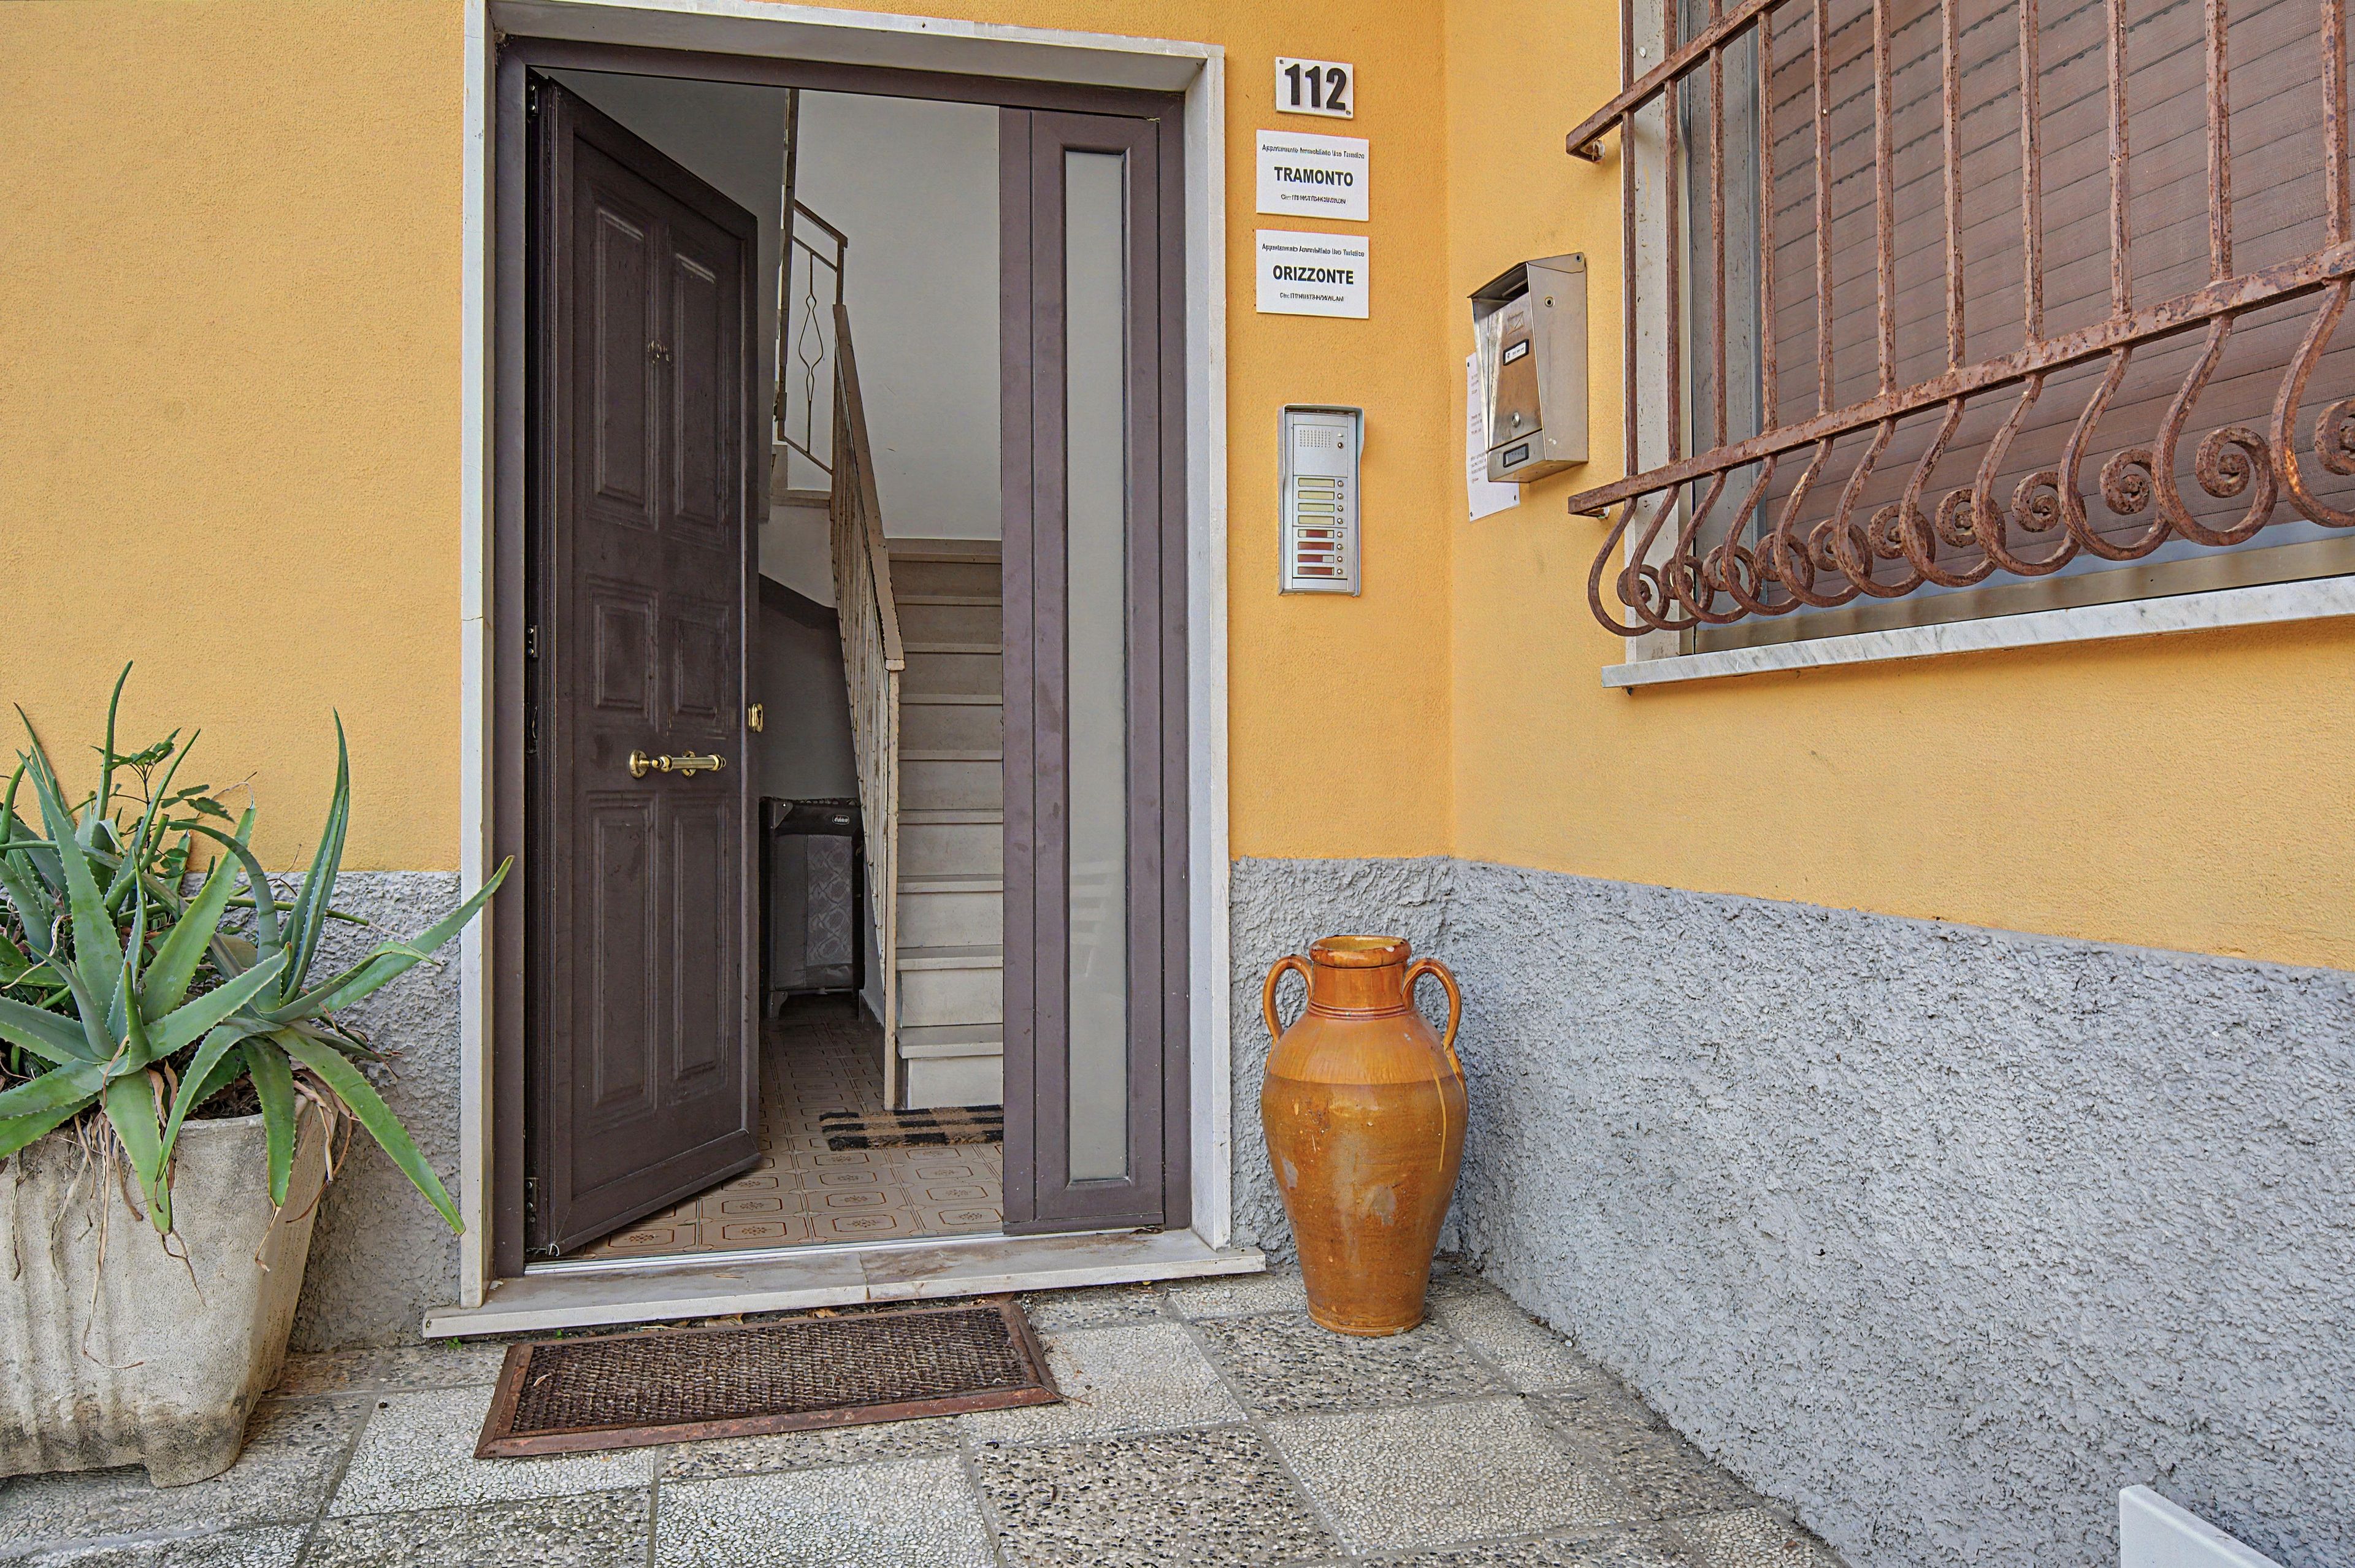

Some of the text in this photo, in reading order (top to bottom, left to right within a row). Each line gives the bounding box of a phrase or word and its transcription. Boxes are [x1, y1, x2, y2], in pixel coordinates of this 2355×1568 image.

[1285, 64, 1347, 110] 112
[1274, 166, 1354, 187] TRAMONTO
[1273, 265, 1354, 285] ORIZZONTE
